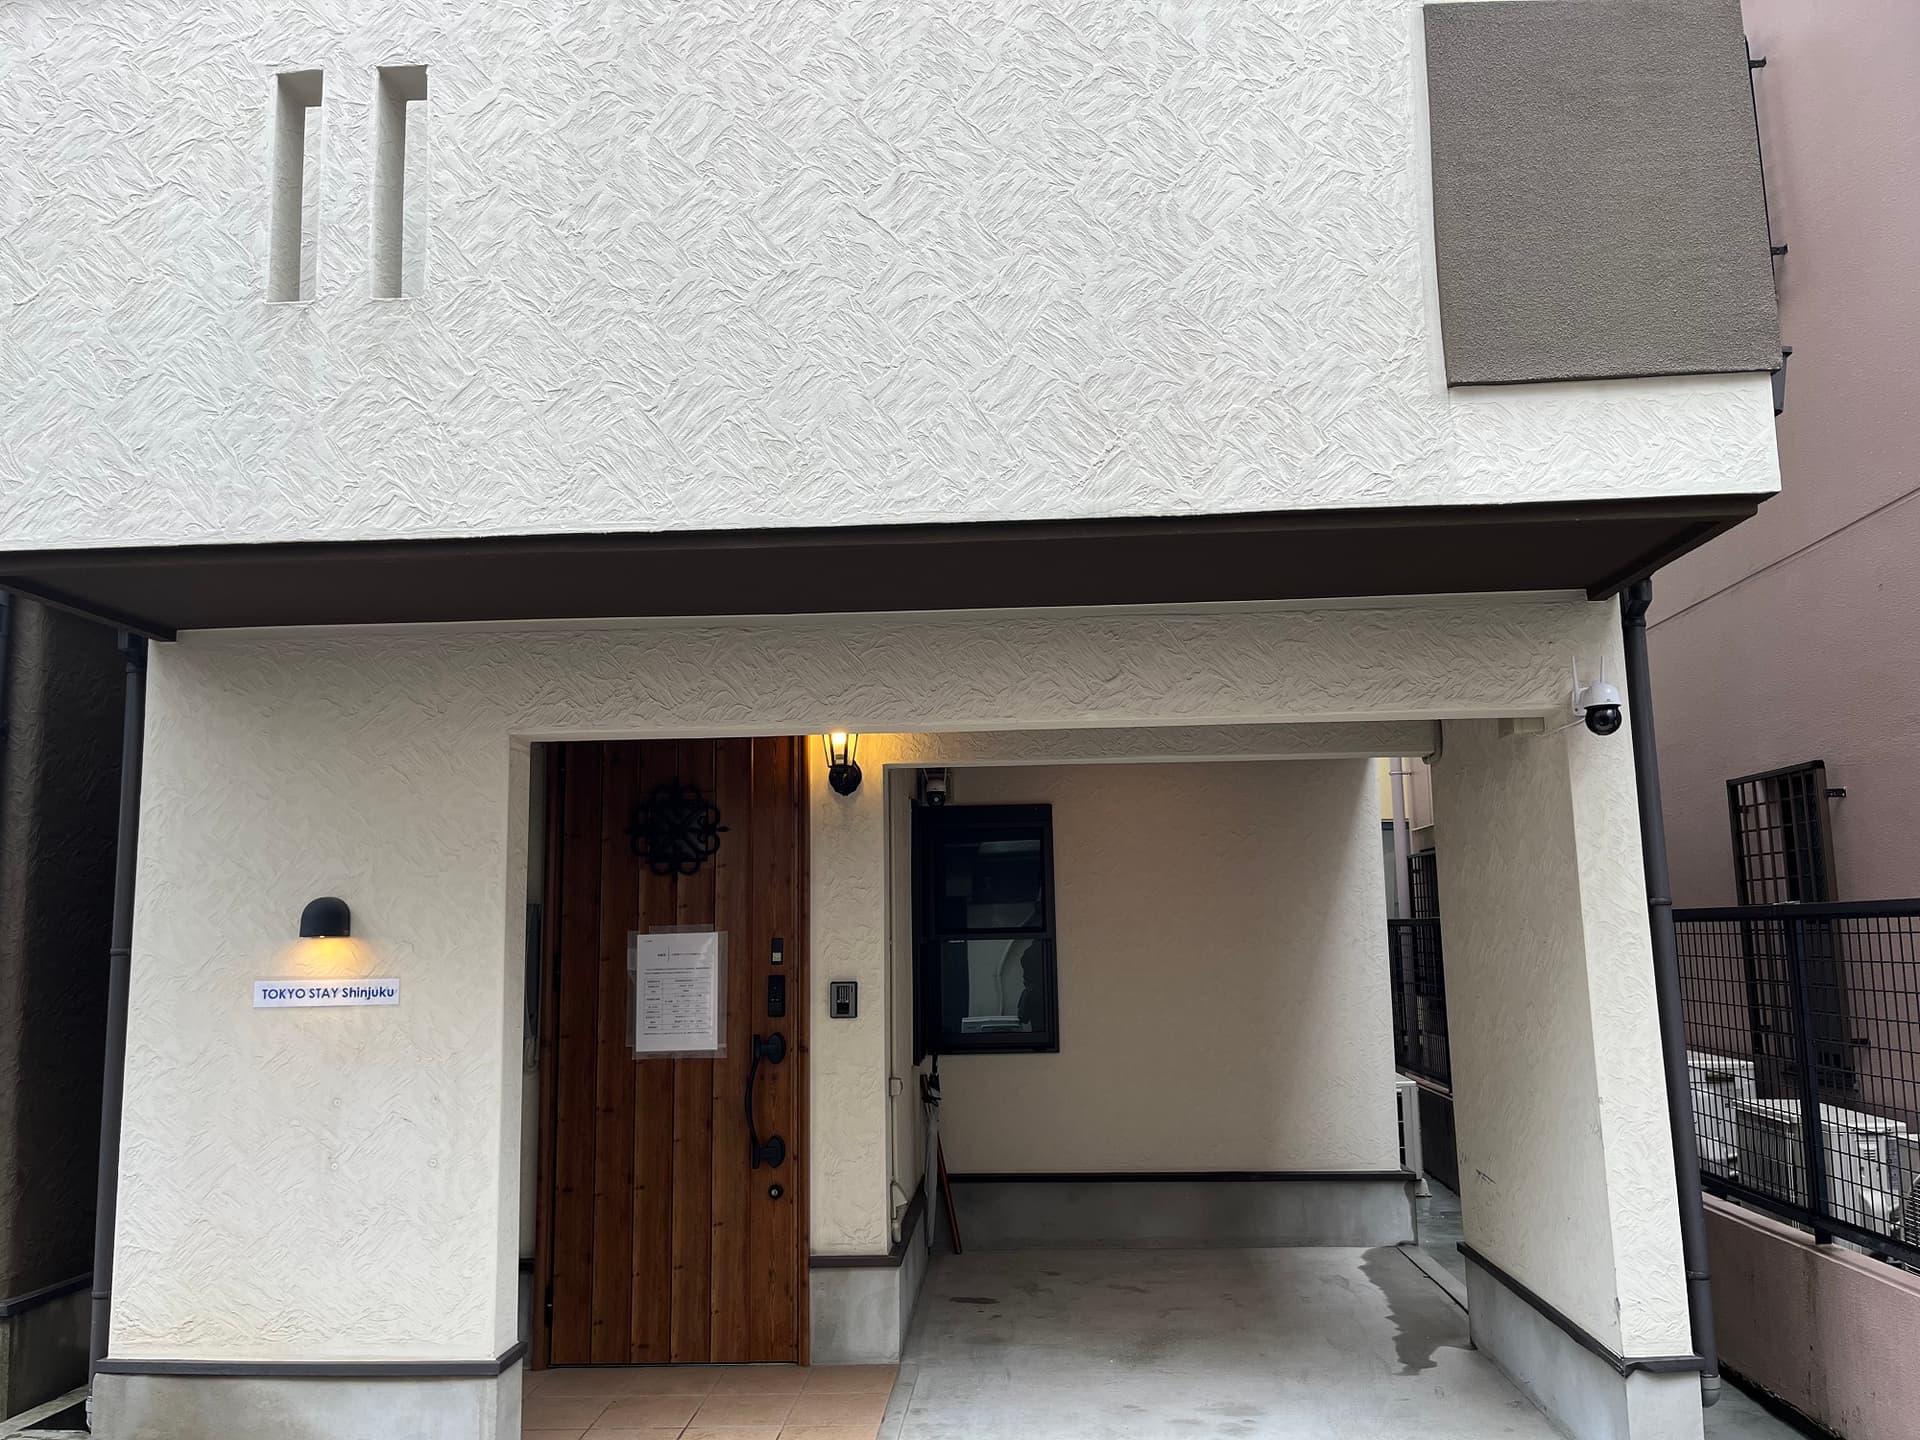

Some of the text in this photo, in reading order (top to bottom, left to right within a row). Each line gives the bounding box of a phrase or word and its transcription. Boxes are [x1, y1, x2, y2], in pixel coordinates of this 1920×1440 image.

[262, 986, 395, 1000] TOKYO STAY Shinjuku
